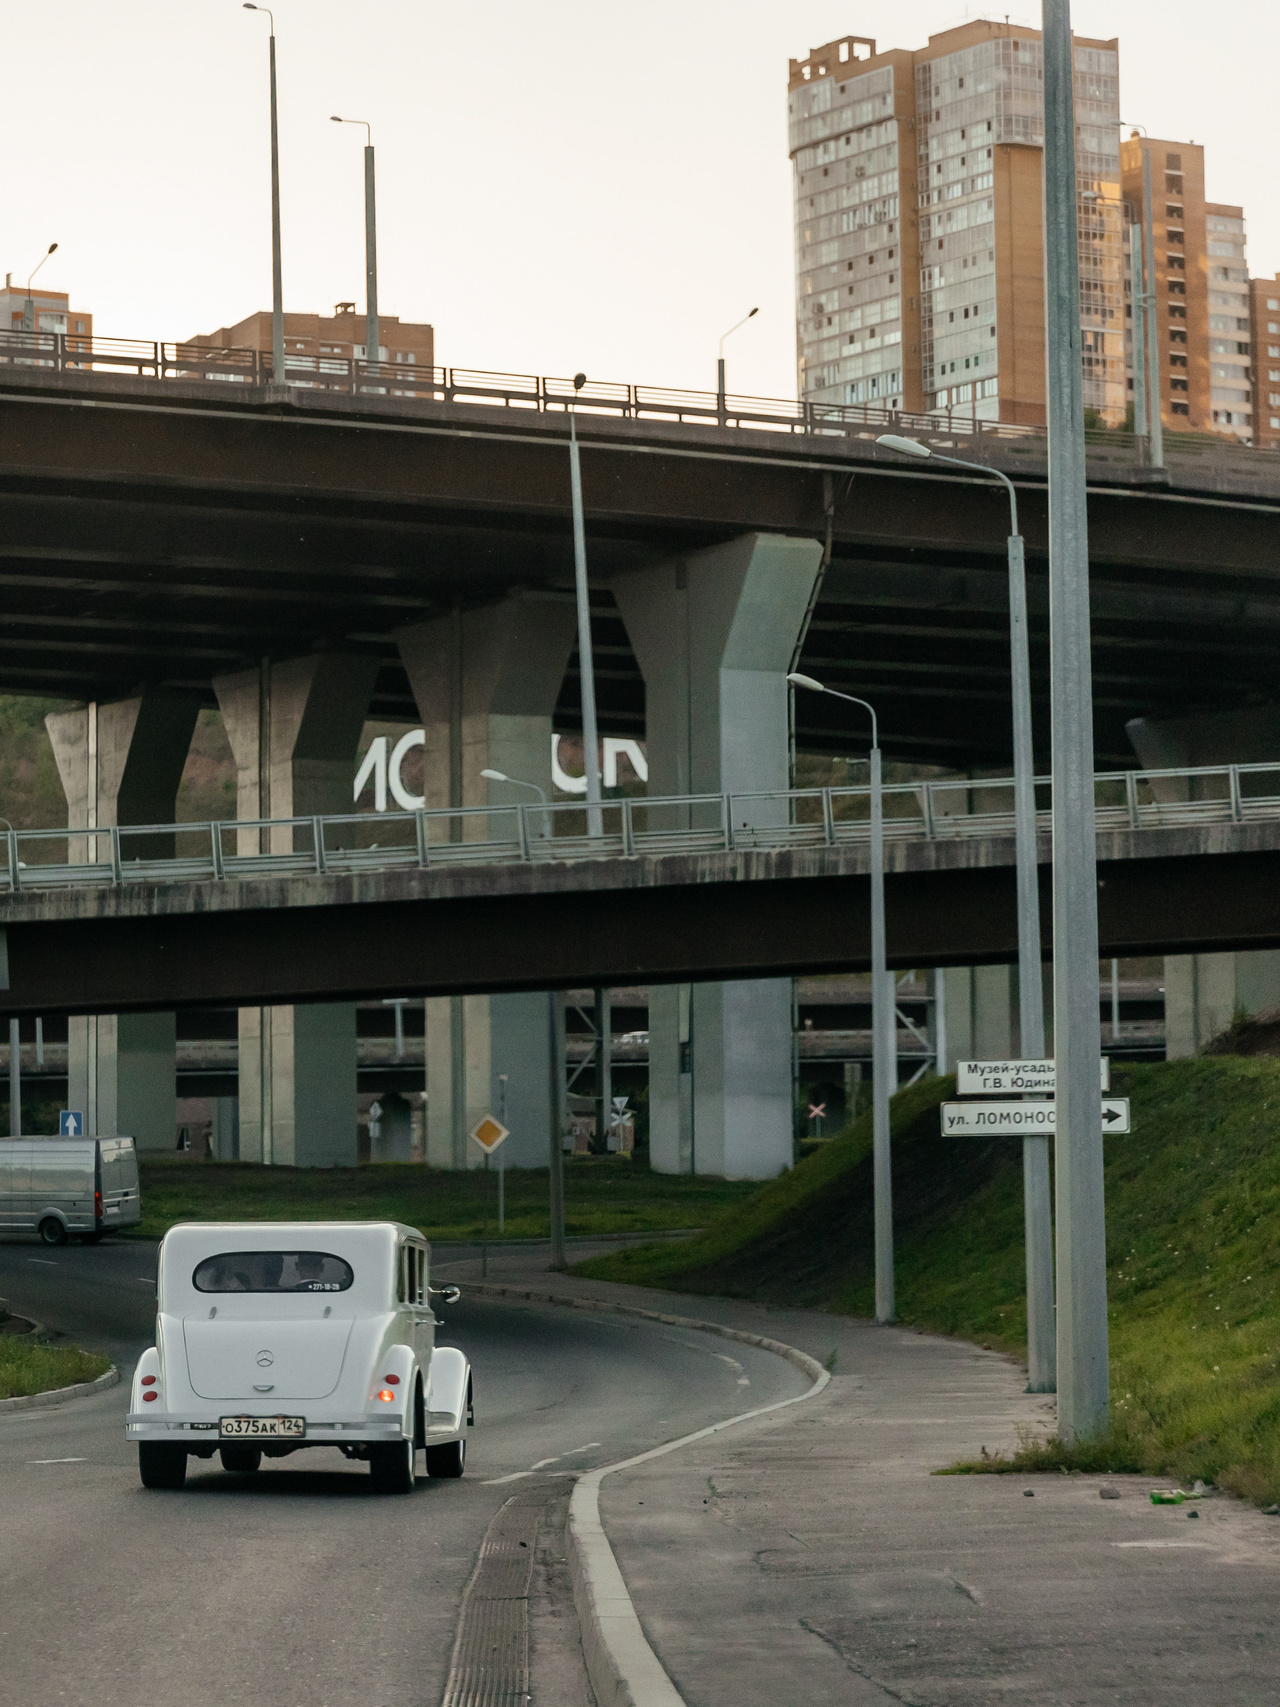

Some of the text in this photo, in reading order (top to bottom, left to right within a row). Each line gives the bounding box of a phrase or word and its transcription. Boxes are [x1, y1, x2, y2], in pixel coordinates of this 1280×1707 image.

[967, 1063, 1055, 1077] Музей-усадь
[983, 1078, 1006, 1088] Г.В.
[948, 1110, 1055, 1127] ул. ЛОМОНОС
[280, 1419, 302, 1430] 124
